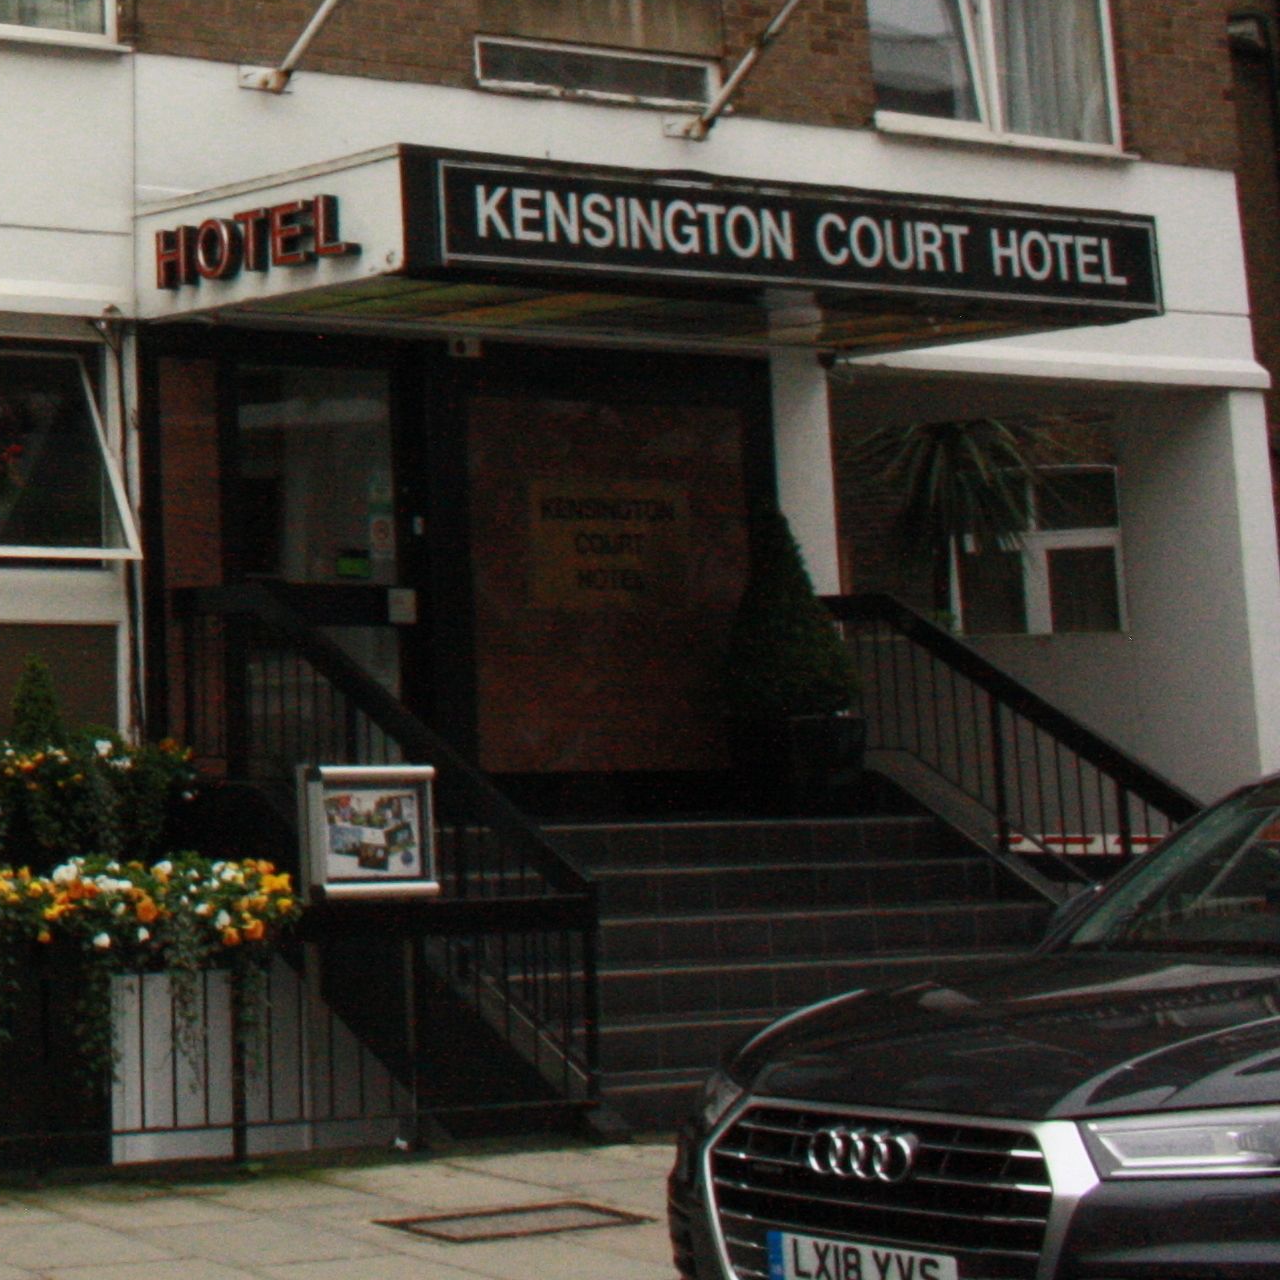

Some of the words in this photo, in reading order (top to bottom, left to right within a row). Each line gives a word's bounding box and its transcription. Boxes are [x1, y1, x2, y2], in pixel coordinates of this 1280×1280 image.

[155, 194, 359, 289] HOTEL
[474, 184, 795, 261] KENSINGTON
[815, 211, 970, 273] COURT
[990, 226, 1128, 286] HOTEL
[540, 497, 675, 521] KENSINGTON
[575, 531, 644, 555] COURT
[577, 567, 645, 591] HOTEL
[792, 1238, 862, 1280] LX18
